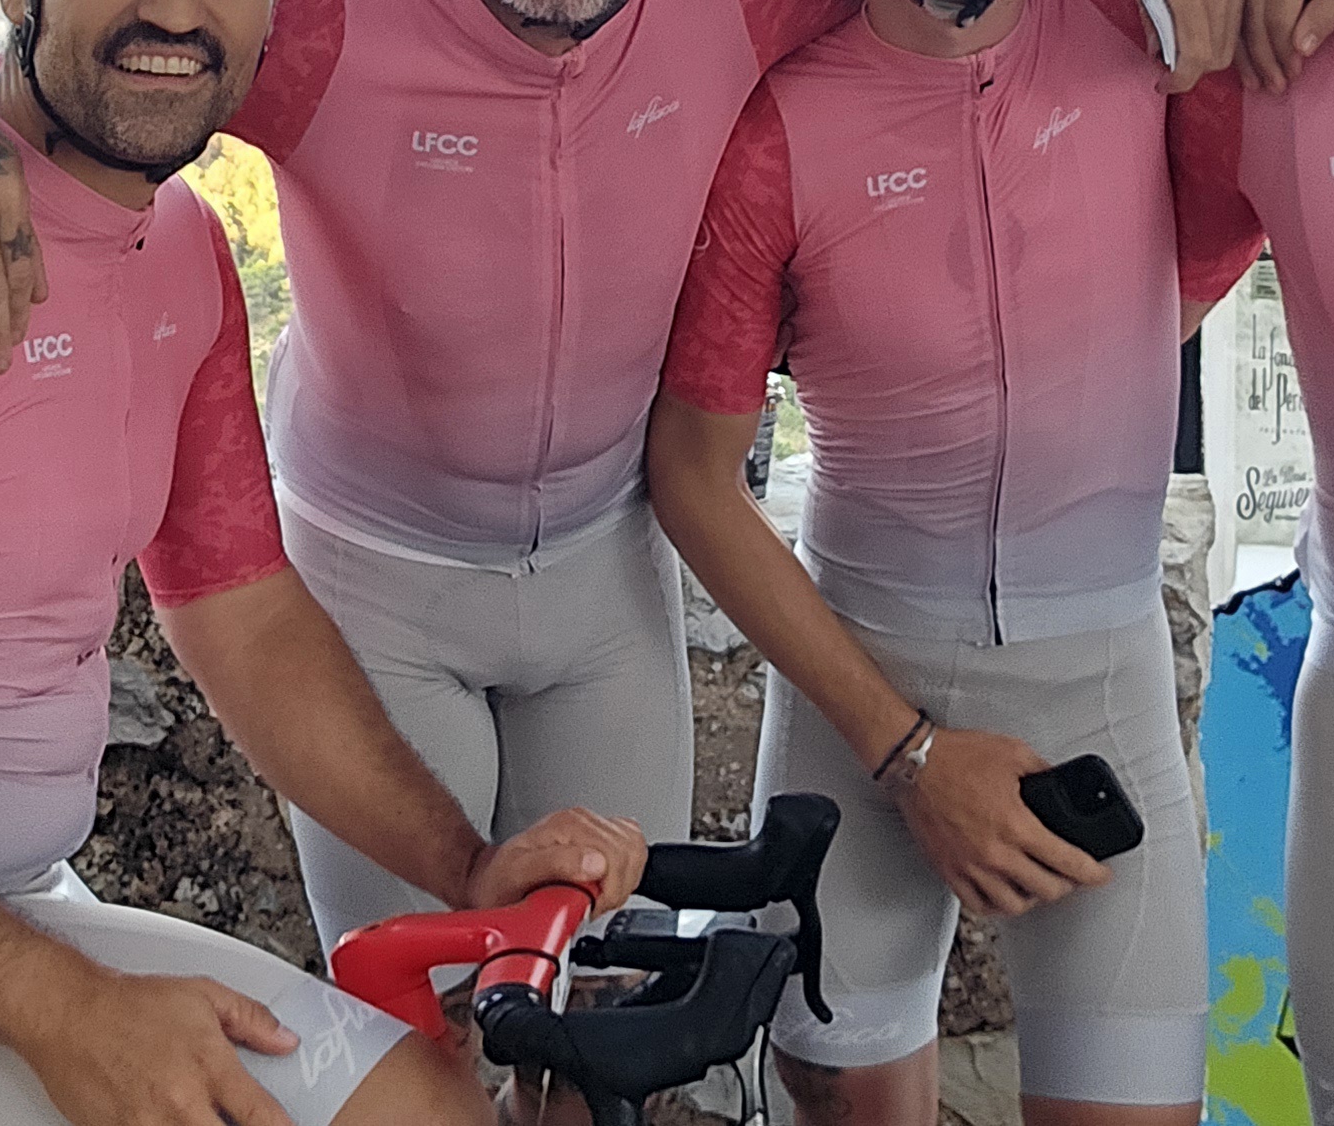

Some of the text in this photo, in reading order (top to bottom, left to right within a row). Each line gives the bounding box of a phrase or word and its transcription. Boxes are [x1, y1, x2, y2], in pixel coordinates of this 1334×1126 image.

[413, 130, 479, 157] LFCC
[867, 168, 928, 199] LFCC
[24, 333, 73, 363] LFCC
